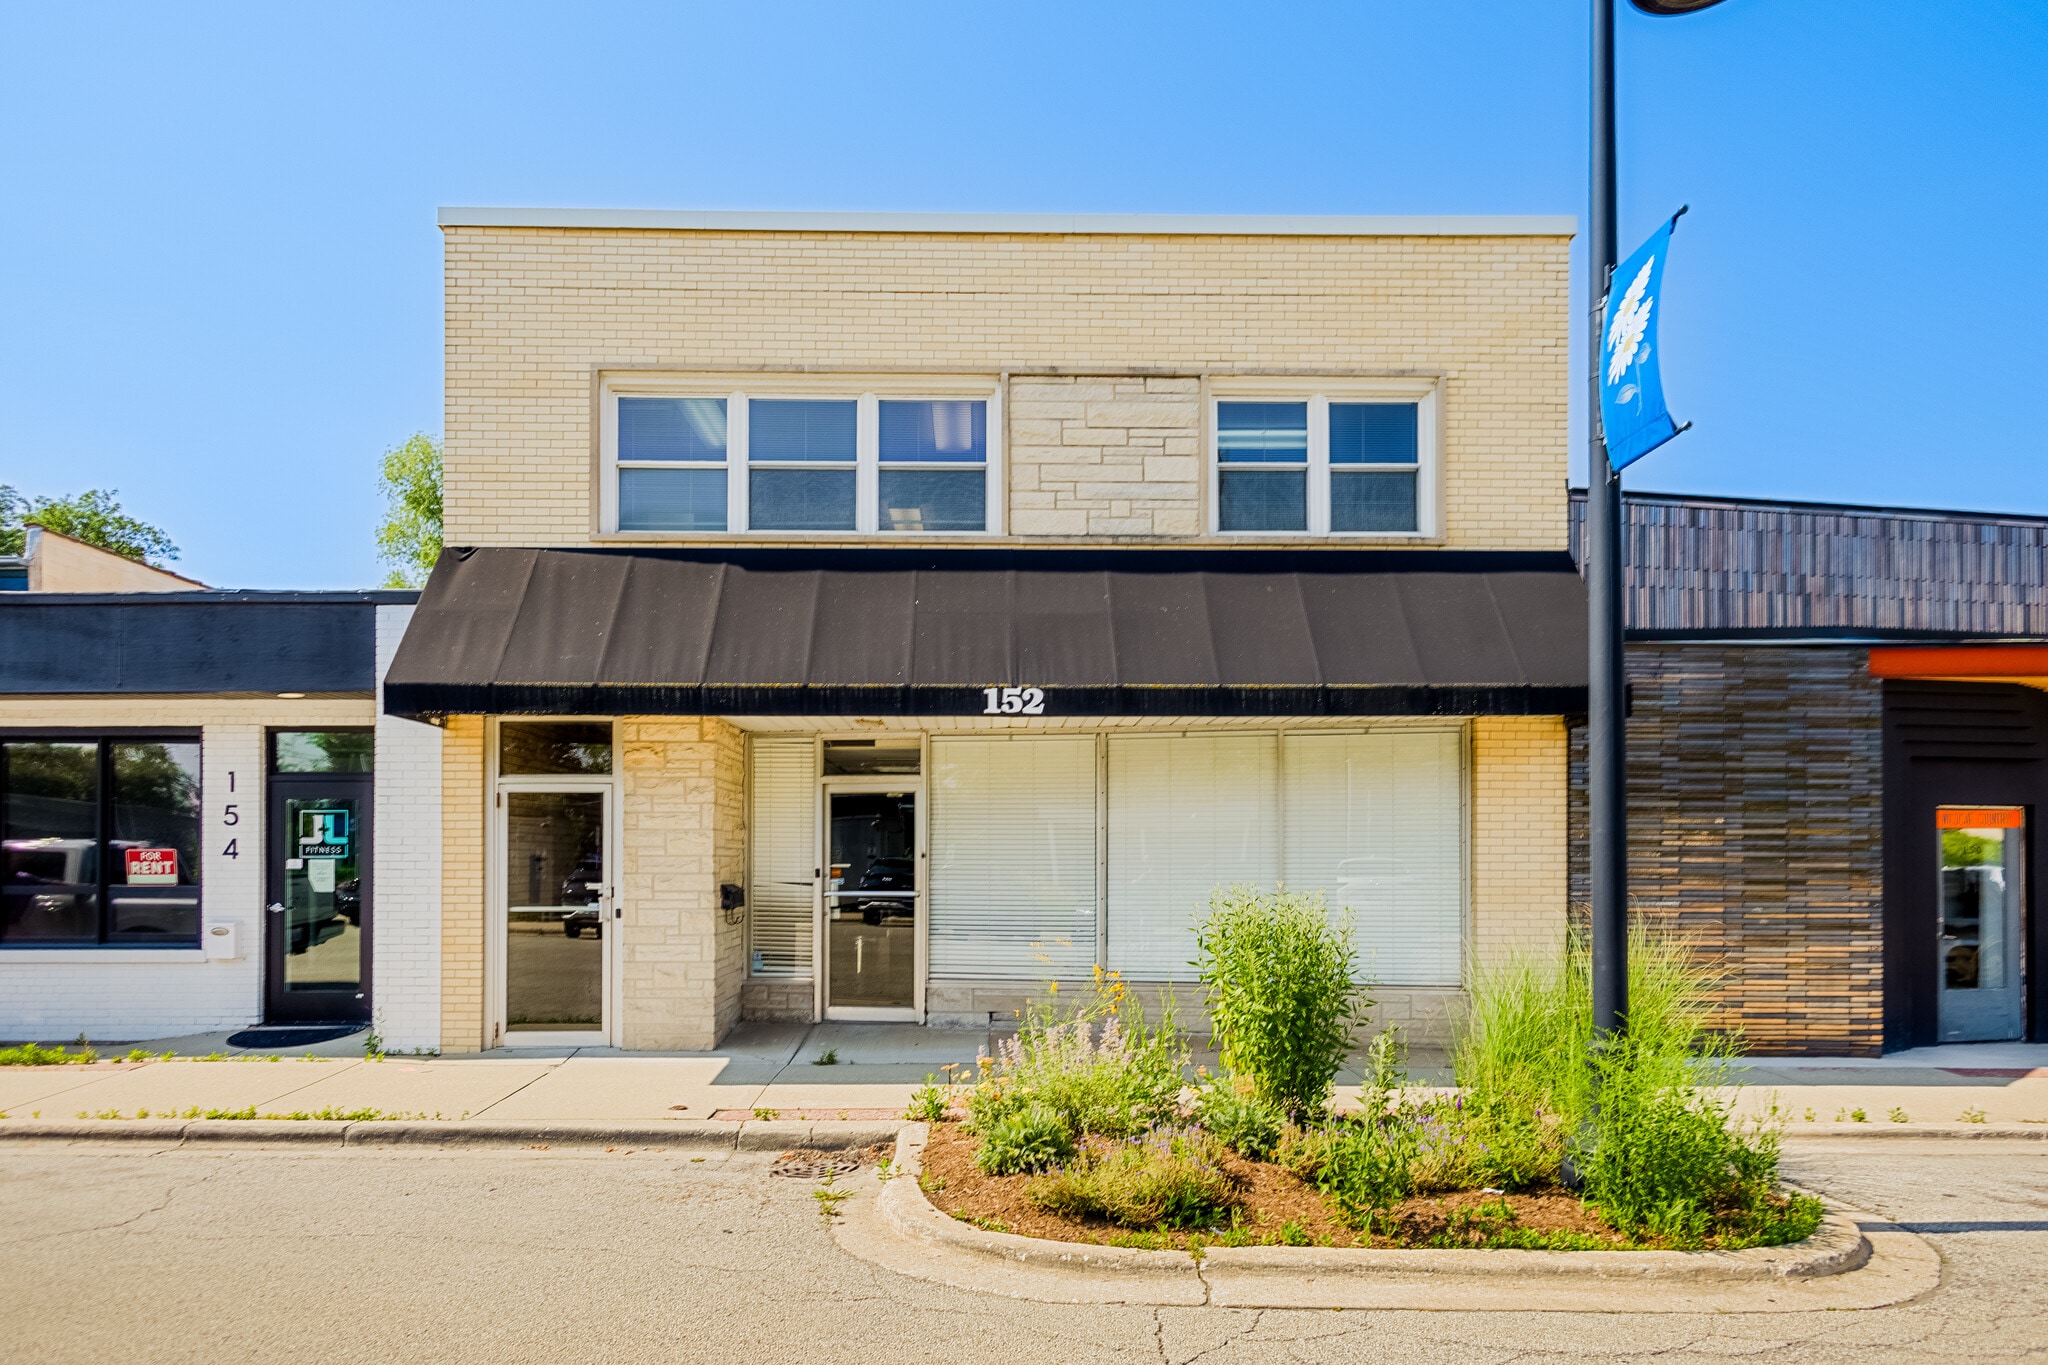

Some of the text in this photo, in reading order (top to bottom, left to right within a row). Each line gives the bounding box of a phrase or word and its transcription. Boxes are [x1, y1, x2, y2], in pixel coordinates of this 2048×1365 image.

[983, 687, 1045, 714] 152
[222, 771, 239, 860] 154
[1978, 812, 2012, 826] COUNTRY
[140, 851, 162, 861] FOR
[305, 846, 342, 854] FITNESS
[130, 861, 174, 874] RENT
